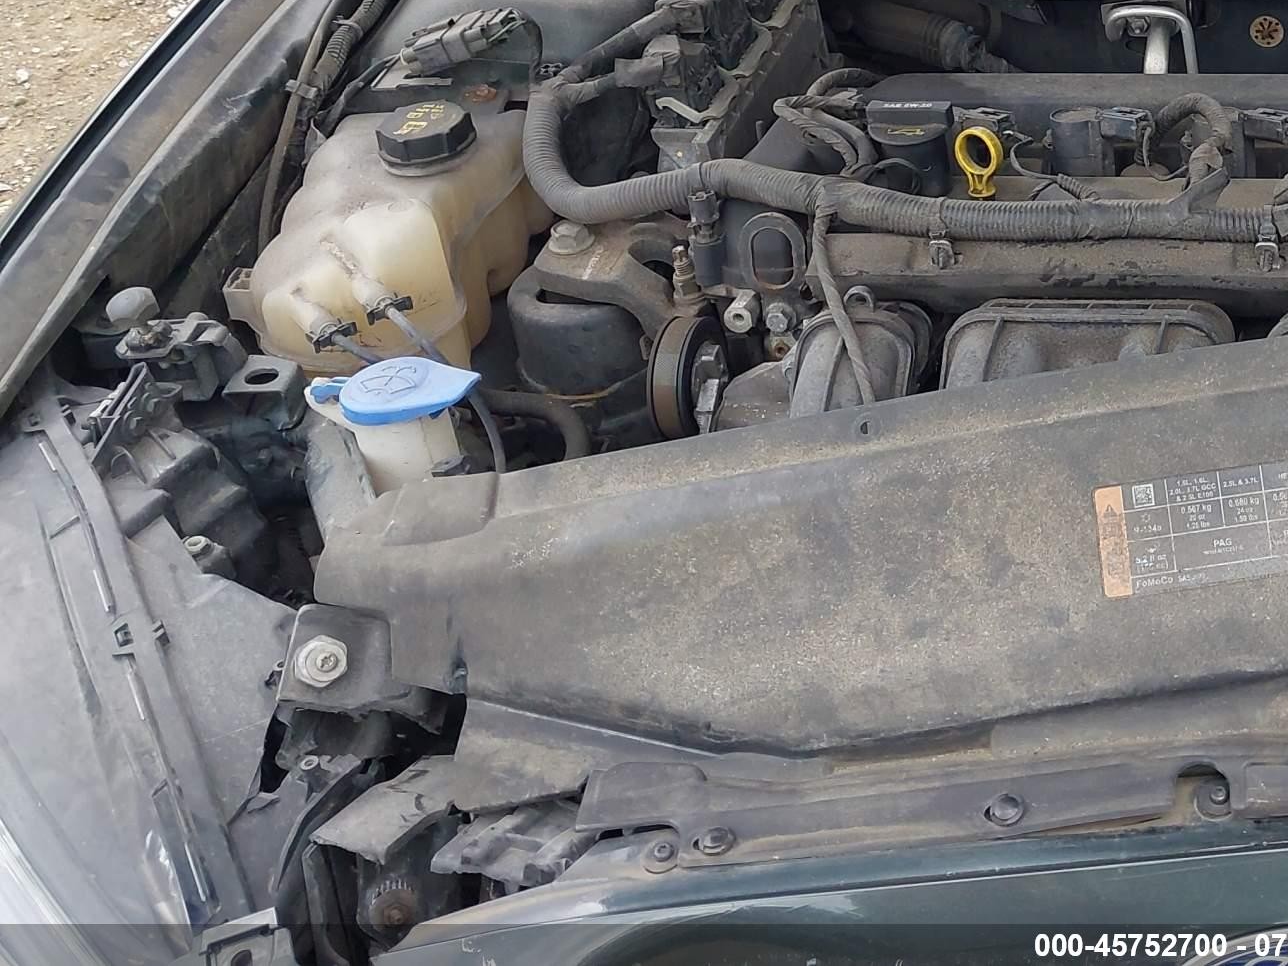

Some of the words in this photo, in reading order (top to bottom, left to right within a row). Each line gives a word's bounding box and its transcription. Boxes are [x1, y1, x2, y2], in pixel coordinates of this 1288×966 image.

[1244, 476, 1258, 484] 3.7L
[1249, 495, 1259, 505] kg
[1202, 502, 1212, 513] kg
[1212, 536, 1232, 547] PAG
[1135, 574, 1173, 588] FoMoCo
